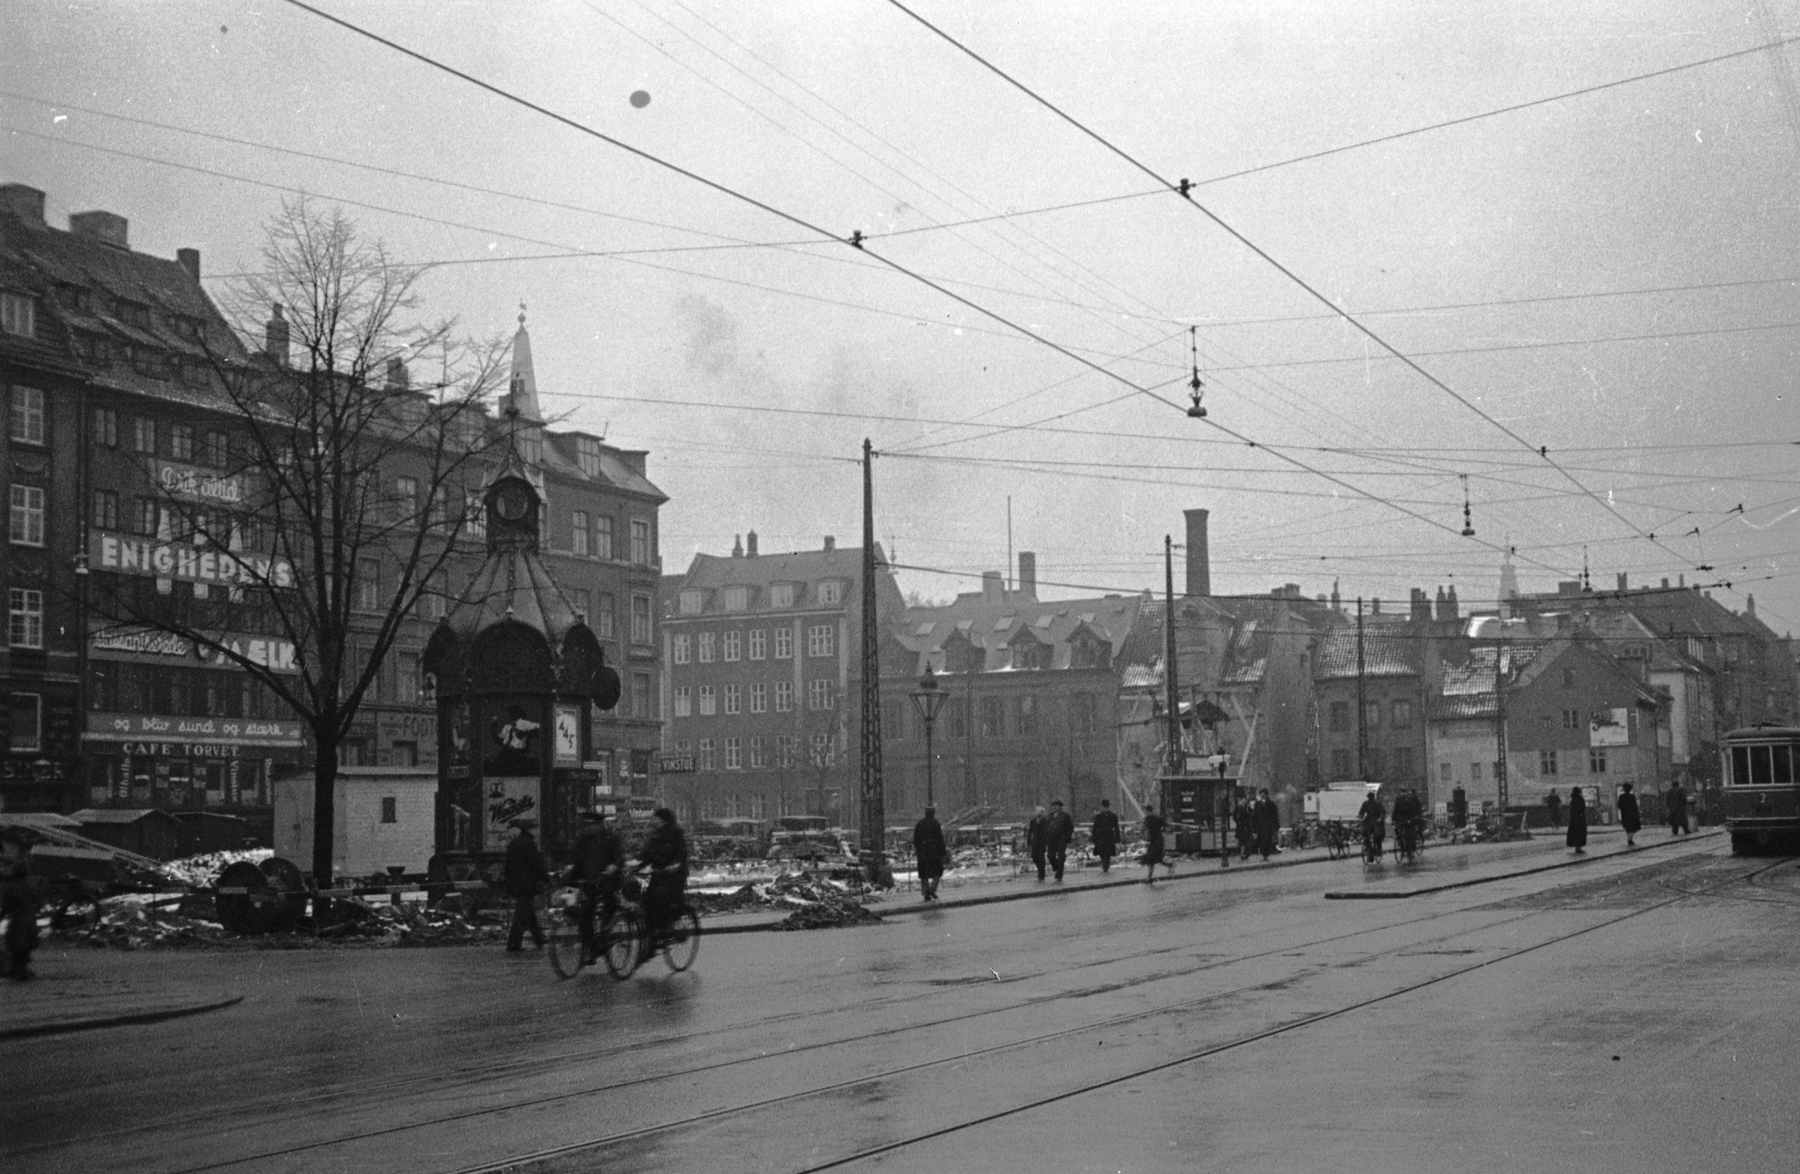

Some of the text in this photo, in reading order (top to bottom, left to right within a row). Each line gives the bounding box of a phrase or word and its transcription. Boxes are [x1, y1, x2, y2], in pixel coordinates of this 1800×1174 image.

[102, 536, 292, 588] ENIGHEDENS
[114, 718, 130, 731] og
[178, 719, 216, 734] sund
[223, 723, 240, 736] og
